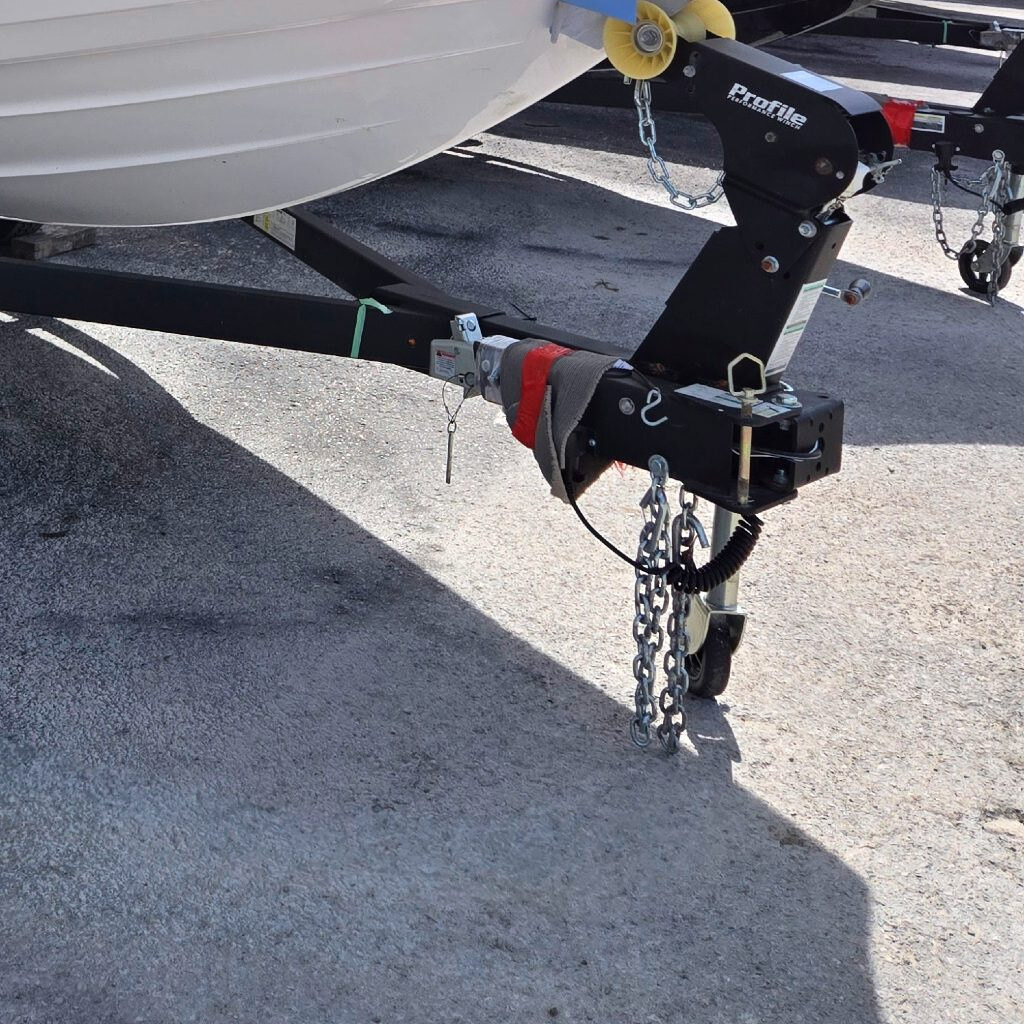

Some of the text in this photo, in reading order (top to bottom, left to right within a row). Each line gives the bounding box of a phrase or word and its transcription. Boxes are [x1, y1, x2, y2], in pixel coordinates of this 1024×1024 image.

[727, 94, 802, 130] PERFORMANCE WINCH
[728, 82, 807, 126] Profile
